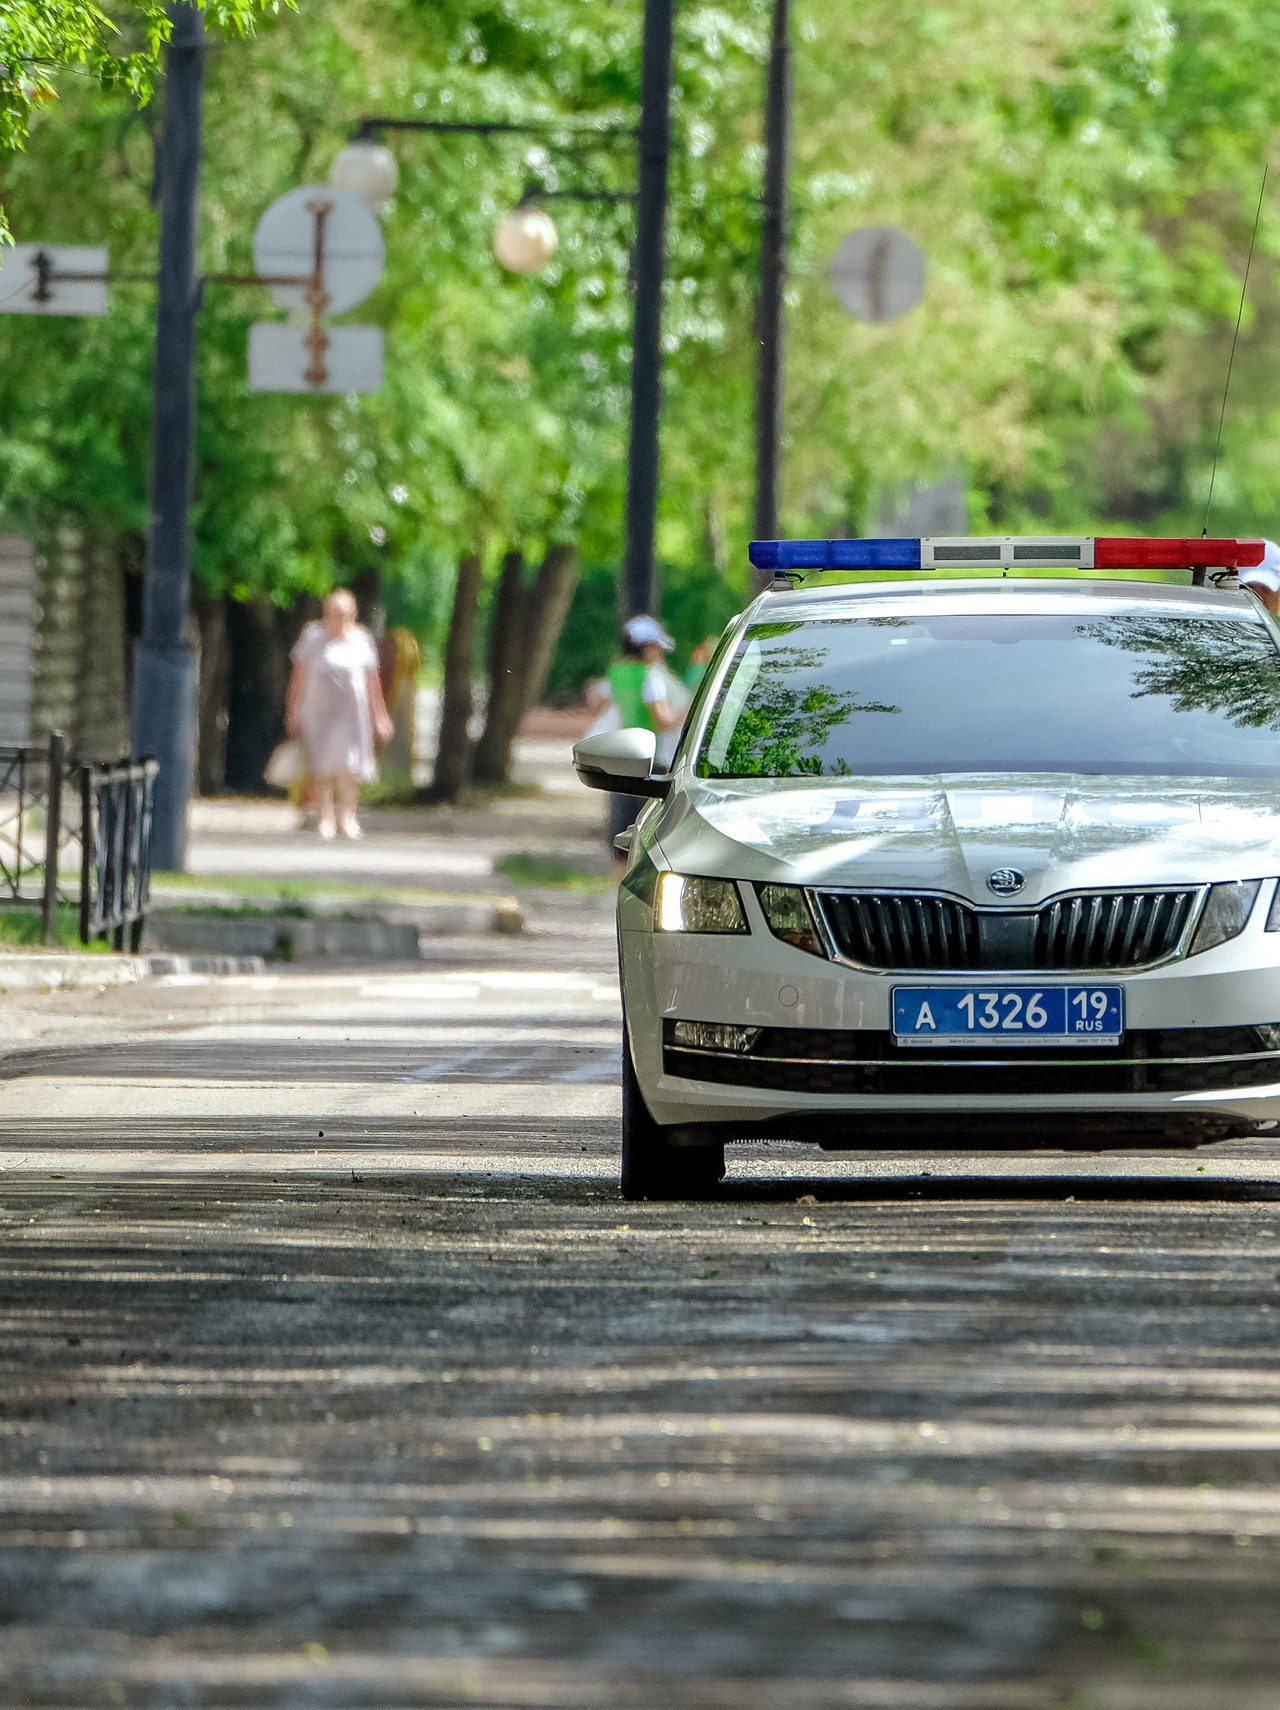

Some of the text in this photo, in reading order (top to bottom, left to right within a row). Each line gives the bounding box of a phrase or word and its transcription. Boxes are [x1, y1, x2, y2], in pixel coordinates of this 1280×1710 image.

[914, 991, 1108, 1029] А 1326 19
[1075, 1020, 1104, 1031] RUS
